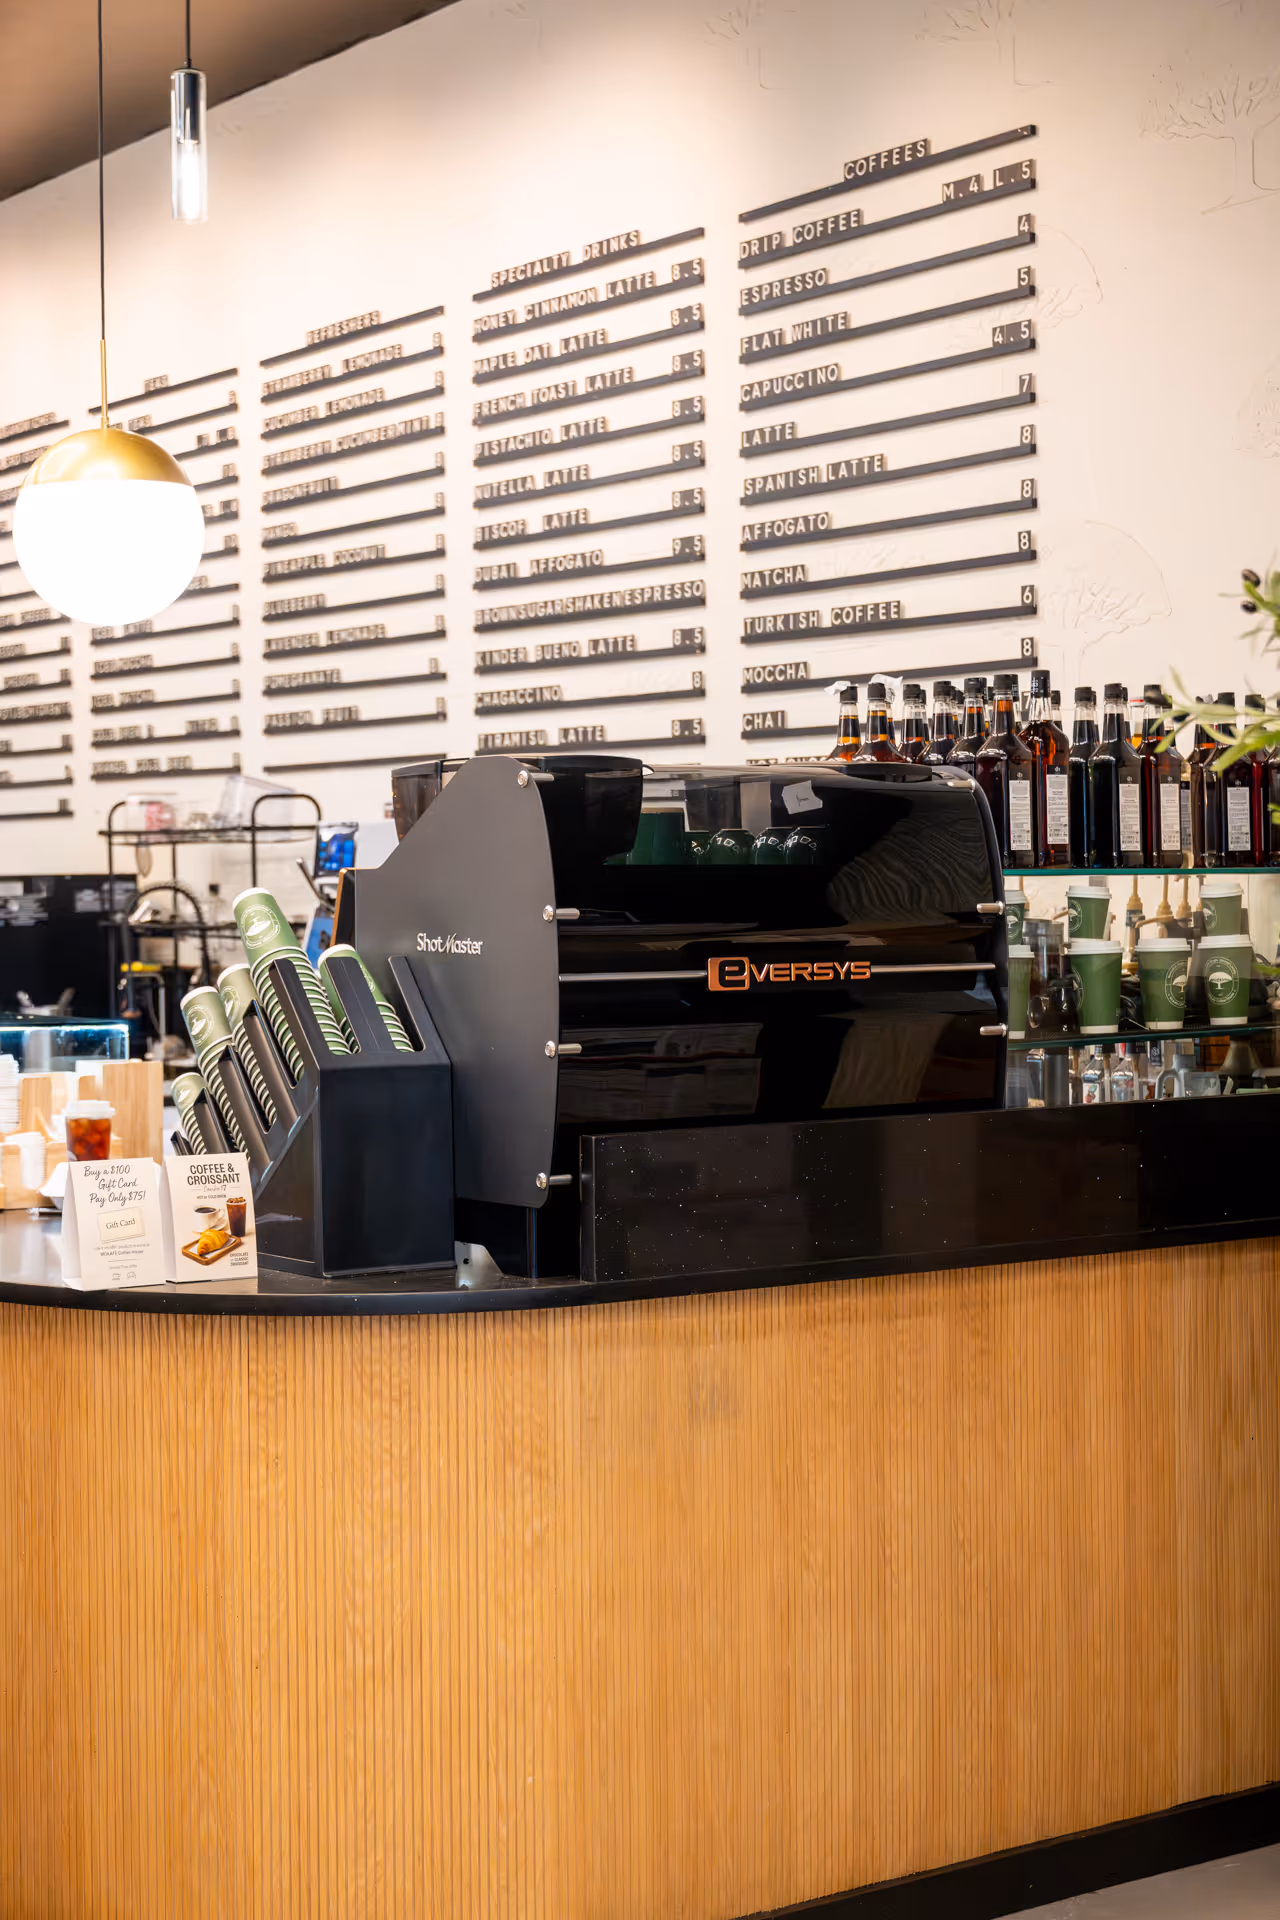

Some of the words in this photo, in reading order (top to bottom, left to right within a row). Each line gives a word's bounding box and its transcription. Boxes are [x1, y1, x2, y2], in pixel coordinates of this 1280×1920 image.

[844, 140, 926, 180] COFFEES
[740, 233, 782, 260] DRIP
[793, 210, 859, 244] COFFEE
[943, 176, 979, 202] M.4
[995, 160, 1031, 188] L.5
[492, 251, 569, 288] SPECIALTY
[584, 231, 639, 262] DRINKS
[741, 269, 826, 306] ESPRESSO
[1019, 216, 1030, 233] 4
[474, 311, 516, 334] HONEY
[524, 289, 597, 322] CINNAMON
[607, 272, 654, 298] LATTE
[672, 260, 700, 282] 8.5
[742, 330, 782, 354] FLAT
[792, 312, 846, 342] WHITE
[1019, 268, 1029, 286] 5
[474, 353, 515, 376] MAPLE
[524, 344, 550, 364] OAT
[561, 330, 606, 354] LATTE
[672, 304, 700, 325] 8.5
[742, 365, 838, 402] CAPUCCINO
[994, 320, 1030, 344] 4.5
[475, 394, 525, 418] FRENCH
[532, 381, 576, 404] TOAST
[586, 368, 632, 392] LATTE
[672, 352, 701, 372] 8.5
[742, 422, 793, 448] LATTE
[1022, 375, 1030, 392] 7
[476, 430, 551, 458] PISTACHIO
[561, 418, 606, 441] LATTE
[672, 397, 701, 416] 8.5
[476, 476, 535, 500] NUTELLA
[544, 466, 588, 487] LATTE
[673, 442, 701, 461] 8.5
[745, 466, 818, 496] SPANISH
[828, 455, 883, 480] LATTE
[1022, 425, 1031, 444] 8
[476, 520, 526, 542] BISCOF
[544, 509, 588, 530] LATTE
[672, 488, 701, 508] 8.5
[742, 514, 828, 542] AFFOGATO
[1022, 480, 1032, 498] 8
[476, 564, 516, 582] DUBAI
[530, 550, 602, 576] AFFOGATO
[673, 536, 701, 554] 9.5
[742, 566, 805, 588] MATCHA
[1020, 532, 1030, 550] 8
[745, 611, 818, 634] TURKISH
[832, 602, 899, 626] COFFEE
[1023, 586, 1032, 604] 6
[476, 648, 526, 666] KINDER
[536, 642, 580, 661] BUENO
[589, 636, 634, 655] LATTE
[674, 628, 702, 646] 8.5
[743, 663, 808, 684] MOCCHA
[1023, 638, 1032, 656] 8
[476, 686, 562, 707] CHAGACCINO
[692, 672, 701, 688] 8
[479, 730, 546, 749] TIRAMISU
[559, 726, 604, 744] LATTE
[672, 719, 701, 736] 8.5
[744, 711, 783, 730] CHAI
[84, 1166, 102, 1180] Buy
[110, 1165, 130, 1174] $100
[98, 1178, 116, 1192] Gift
[118, 1178, 138, 1188] Card
[187, 1173, 240, 1186] CROISSANT
[190, 1164, 225, 1174] COFFEE
[228, 1163, 234, 1172] &
[89, 1193, 106, 1208] Pay
[108, 1192, 127, 1206] Only
[128, 1190, 146, 1201] $75!
[106, 1221, 118, 1229] Gift
[120, 1218, 136, 1226] Card
